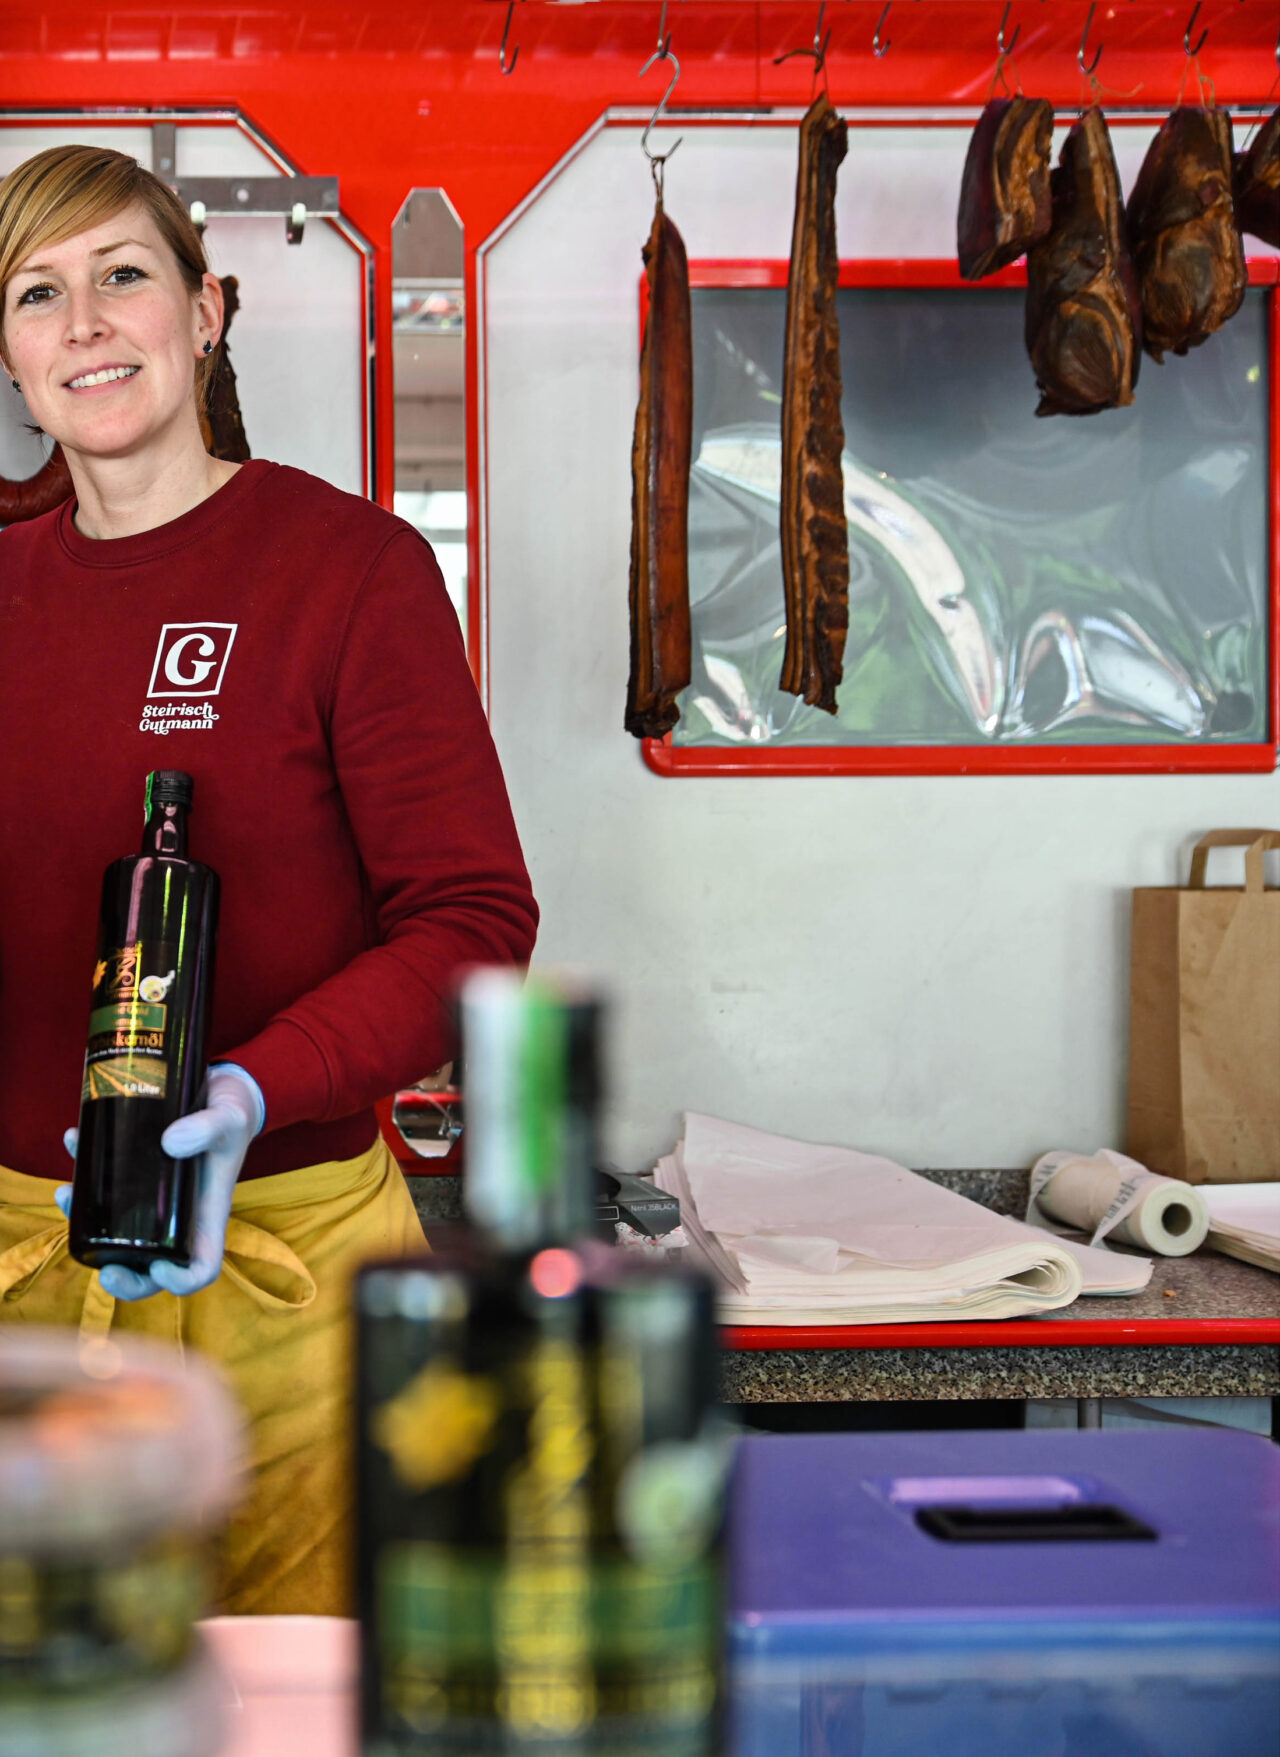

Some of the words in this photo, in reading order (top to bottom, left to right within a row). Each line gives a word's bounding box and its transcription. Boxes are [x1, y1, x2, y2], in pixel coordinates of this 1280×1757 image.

[165, 633, 217, 686] G
[142, 702, 220, 720] Steirisch
[139, 718, 214, 735] Gutmann
